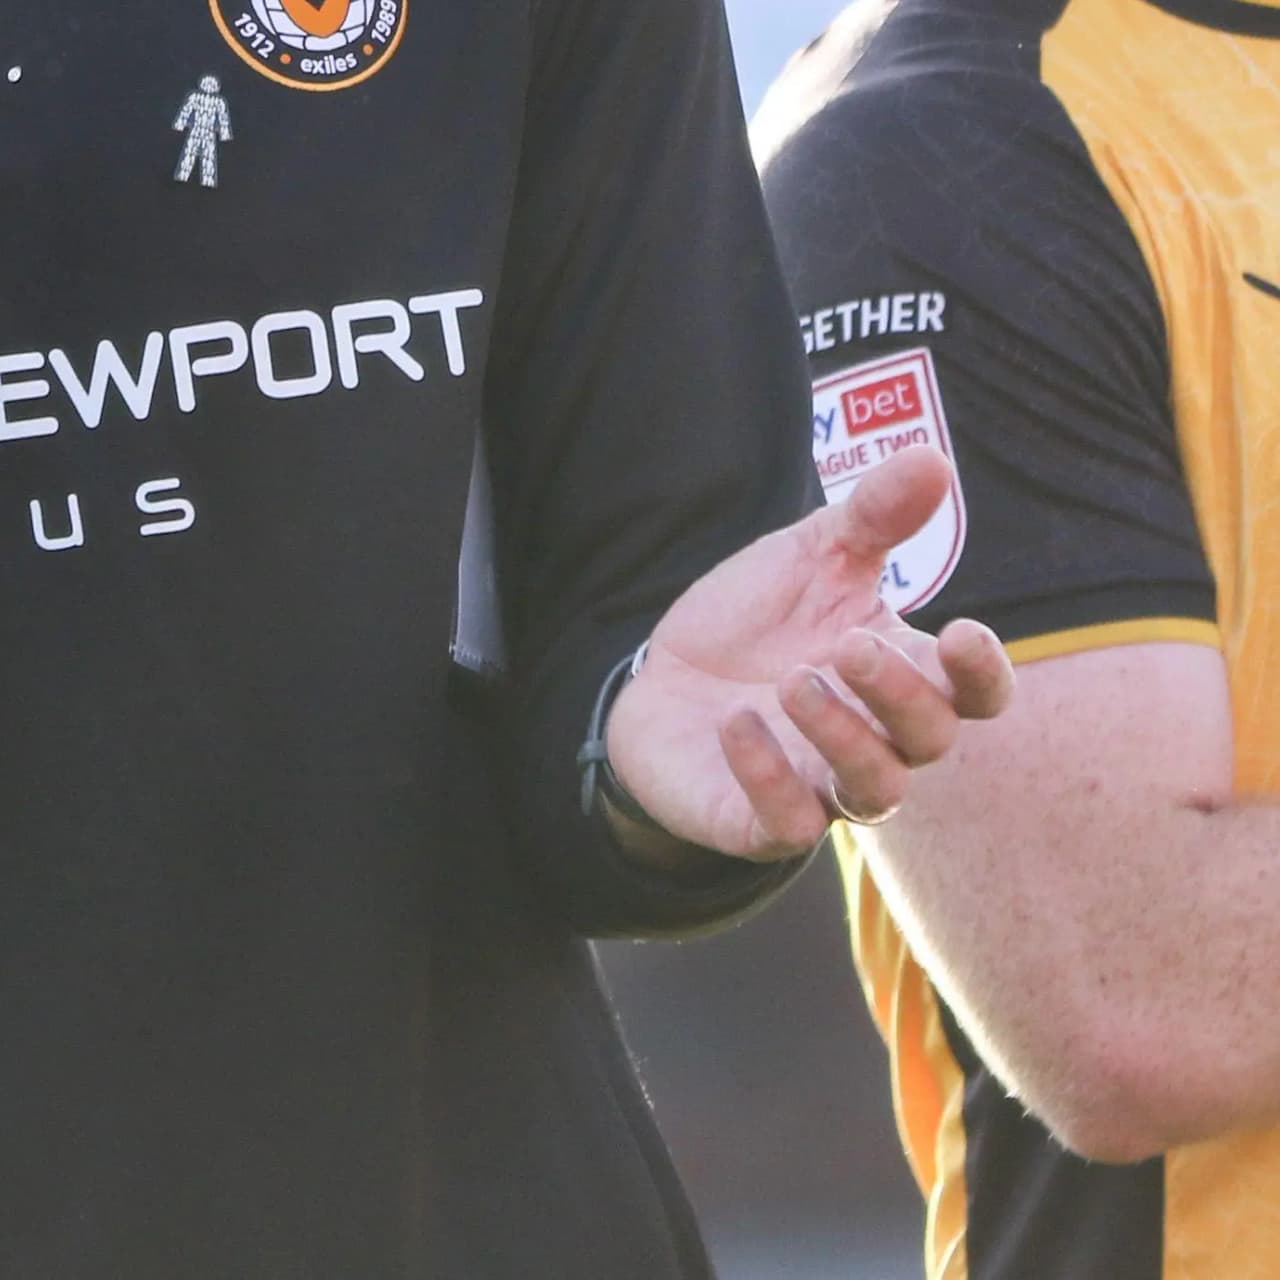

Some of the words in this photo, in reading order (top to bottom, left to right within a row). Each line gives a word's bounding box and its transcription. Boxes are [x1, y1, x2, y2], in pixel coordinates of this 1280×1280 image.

[234, 12, 275, 59] 1912
[300, 53, 357, 75] exiles
[846, 381, 915, 428] bet
